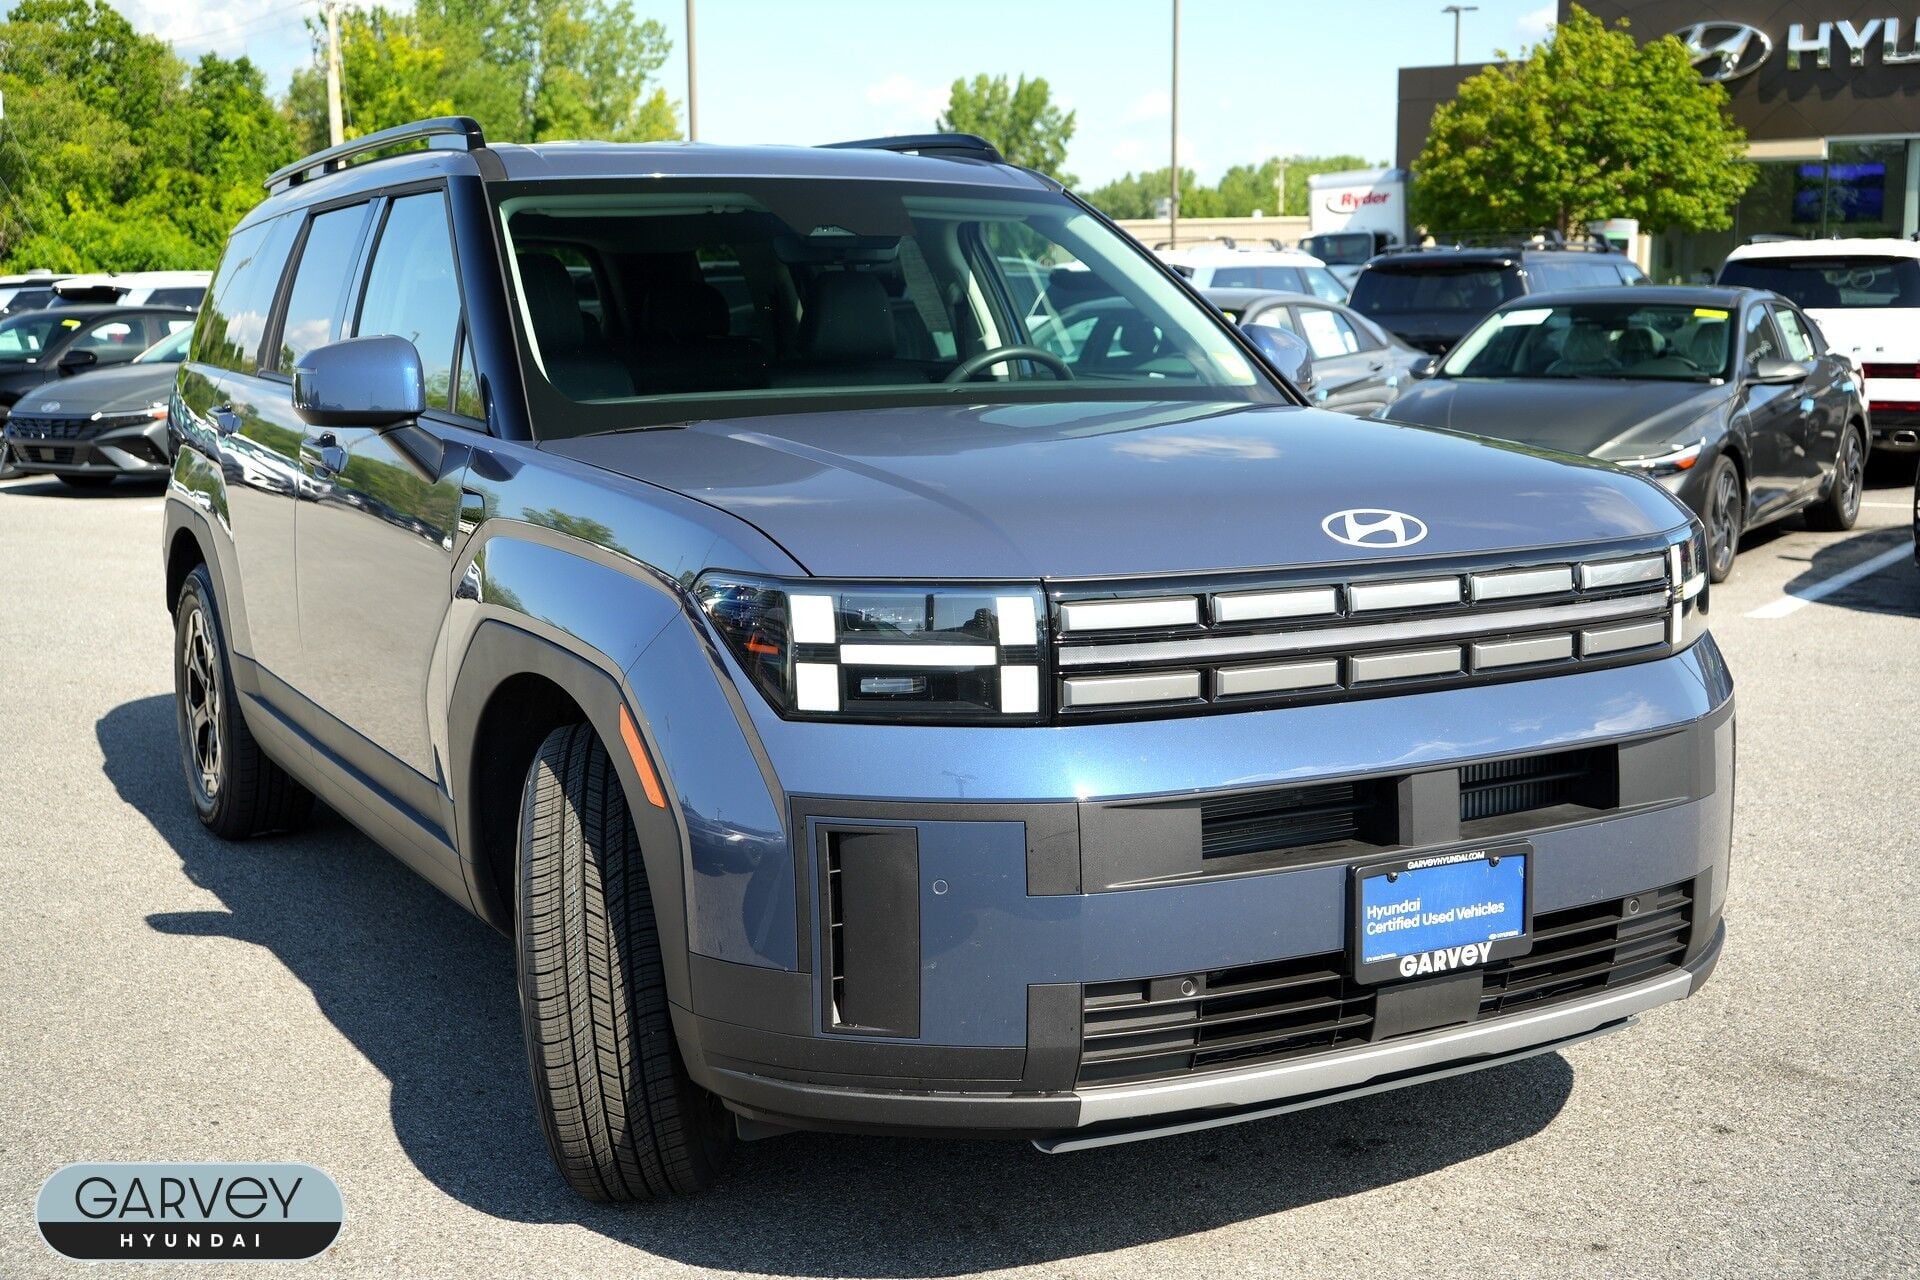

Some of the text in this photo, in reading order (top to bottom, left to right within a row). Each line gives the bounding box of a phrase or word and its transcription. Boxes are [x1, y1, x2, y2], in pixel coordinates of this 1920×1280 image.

[1341, 191, 1390, 209] Ryder
[1366, 901, 1505, 936] Certified Used Vehicles
[1367, 898, 1421, 920] Hyundai
